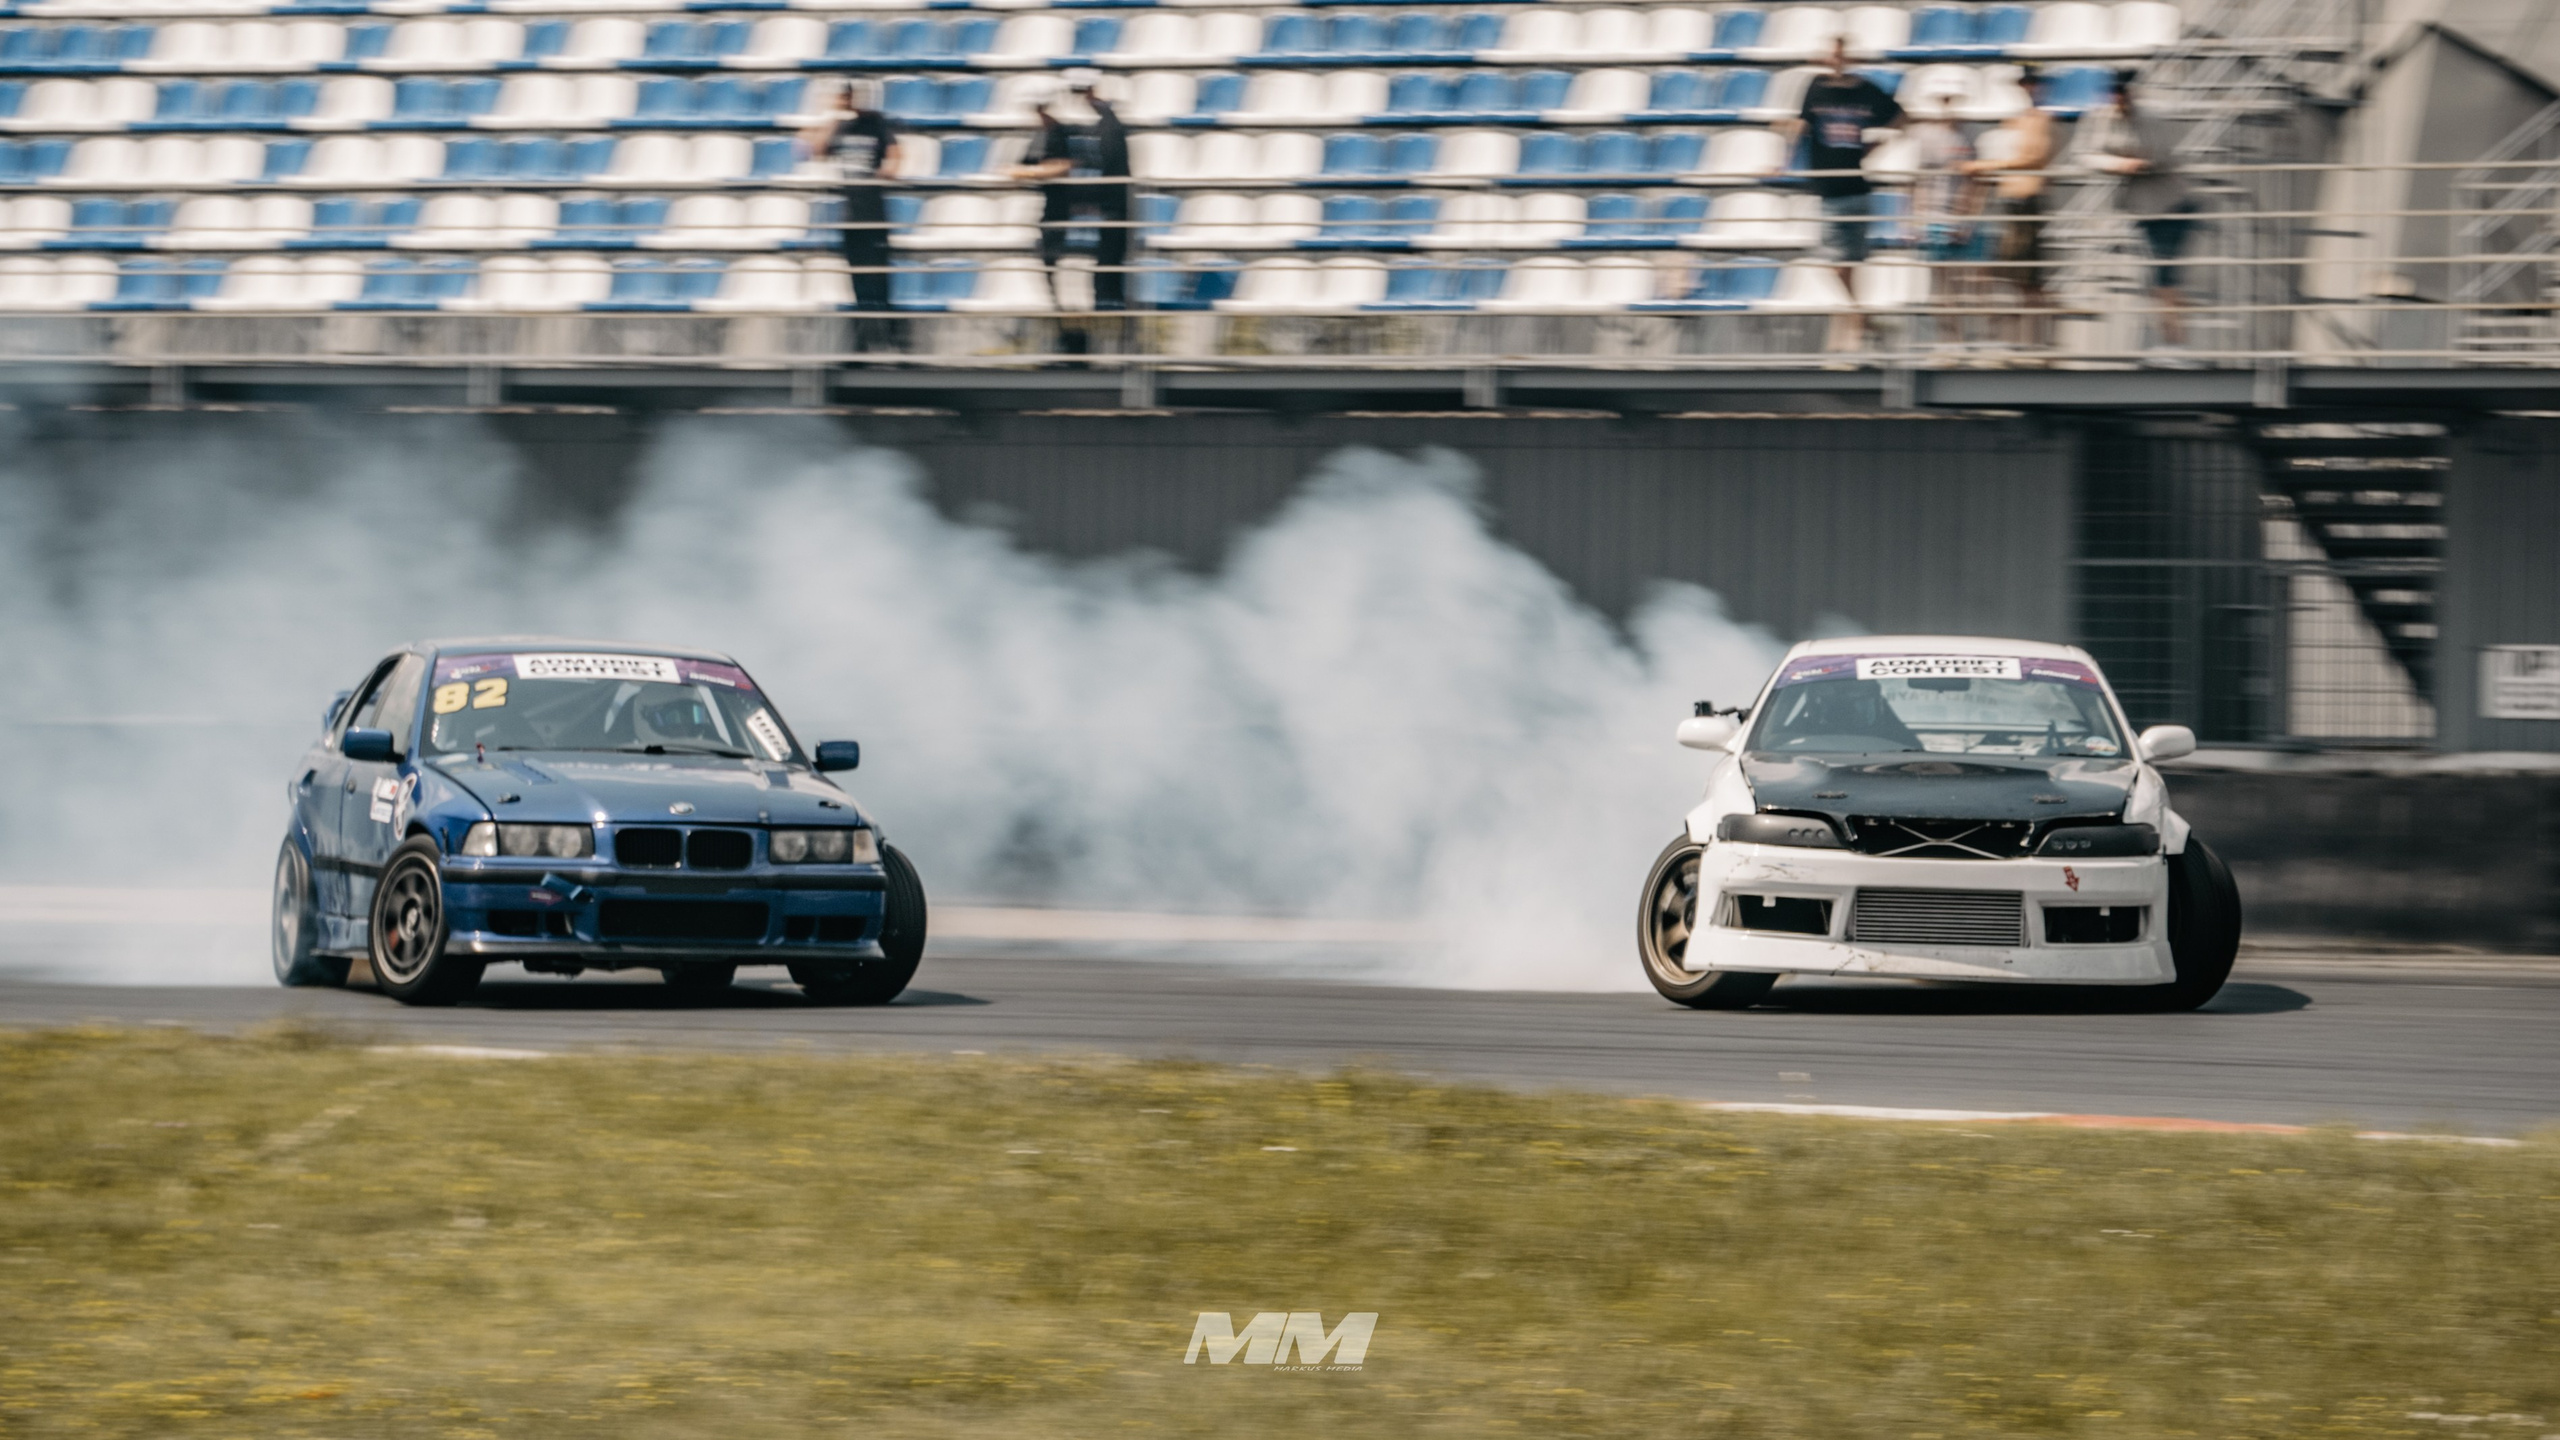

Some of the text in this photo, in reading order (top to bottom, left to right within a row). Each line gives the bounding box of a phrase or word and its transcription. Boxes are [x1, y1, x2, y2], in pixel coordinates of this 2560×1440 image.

[530, 658, 665, 669] ADM DRIFT
[1870, 659, 2008, 667] ADM DRIFT
[530, 666, 667, 677] CONTEST
[1870, 666, 2009, 676] CONTEST
[433, 677, 508, 715] 82
